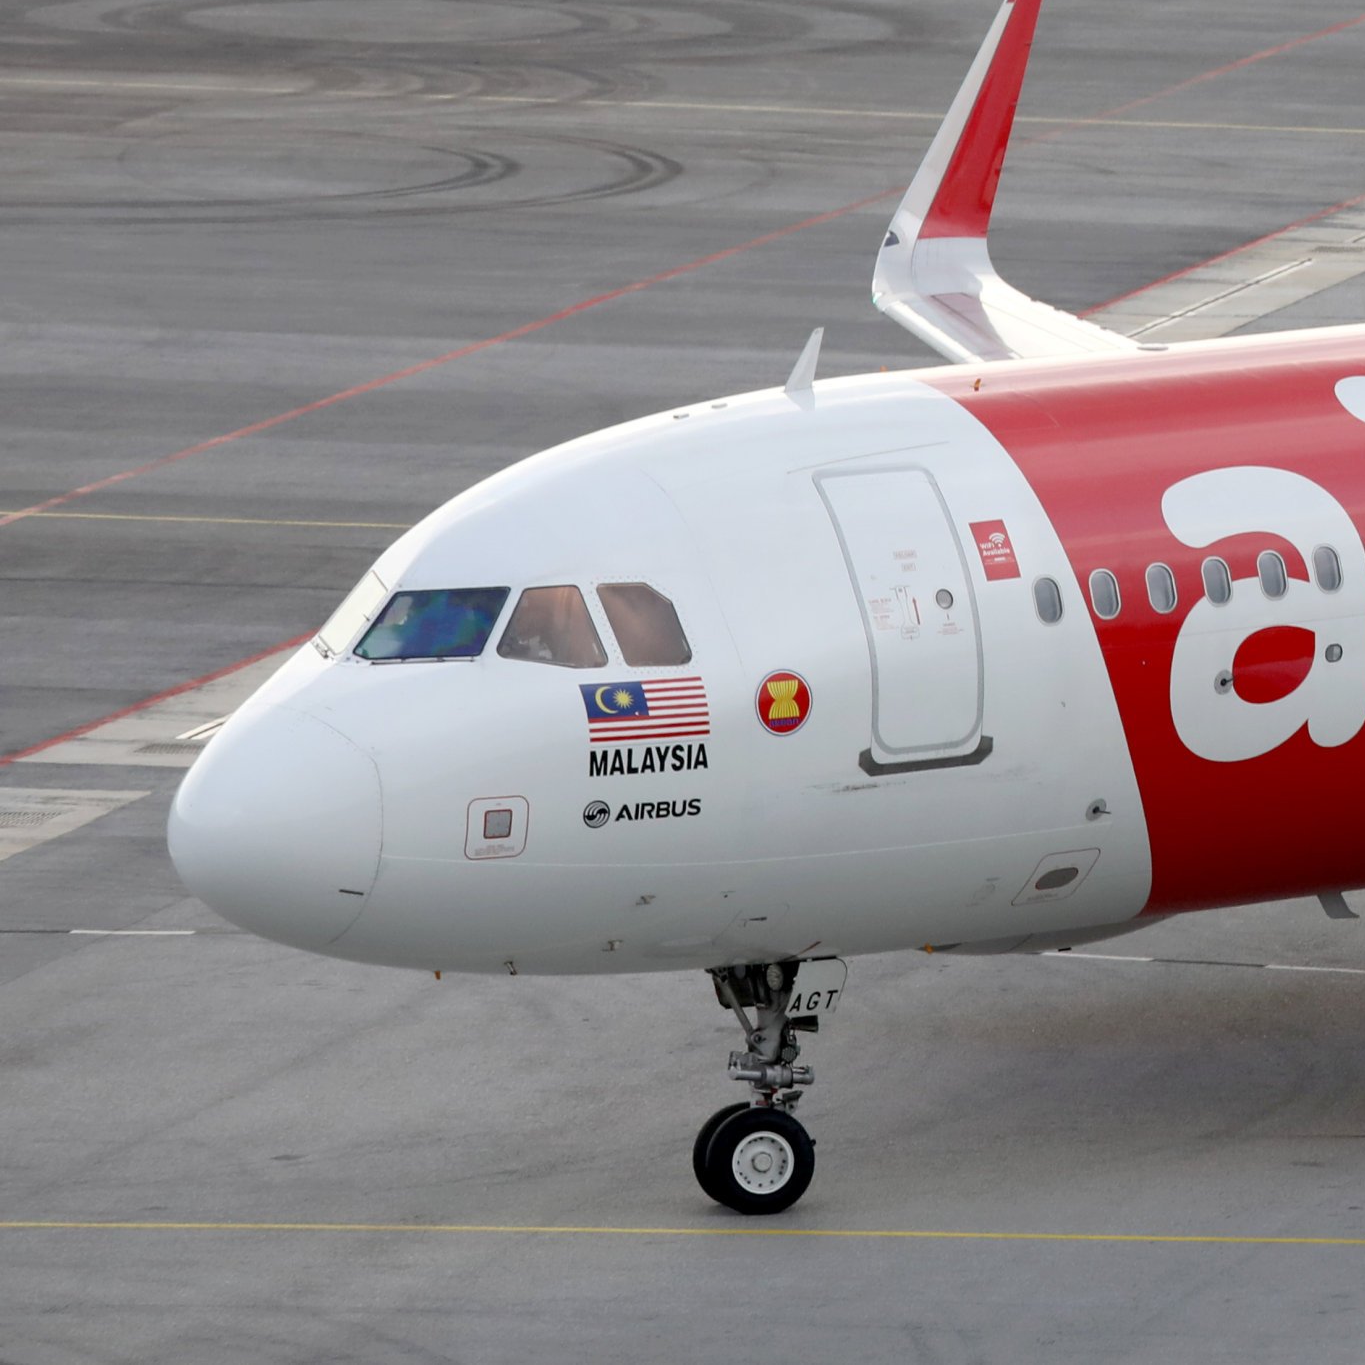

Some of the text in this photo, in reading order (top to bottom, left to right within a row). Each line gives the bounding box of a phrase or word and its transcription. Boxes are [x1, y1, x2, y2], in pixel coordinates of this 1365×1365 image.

[588, 743, 709, 777] MALAYSIA
[614, 798, 702, 822] AIRBUS
[788, 989, 840, 1013] AGT
